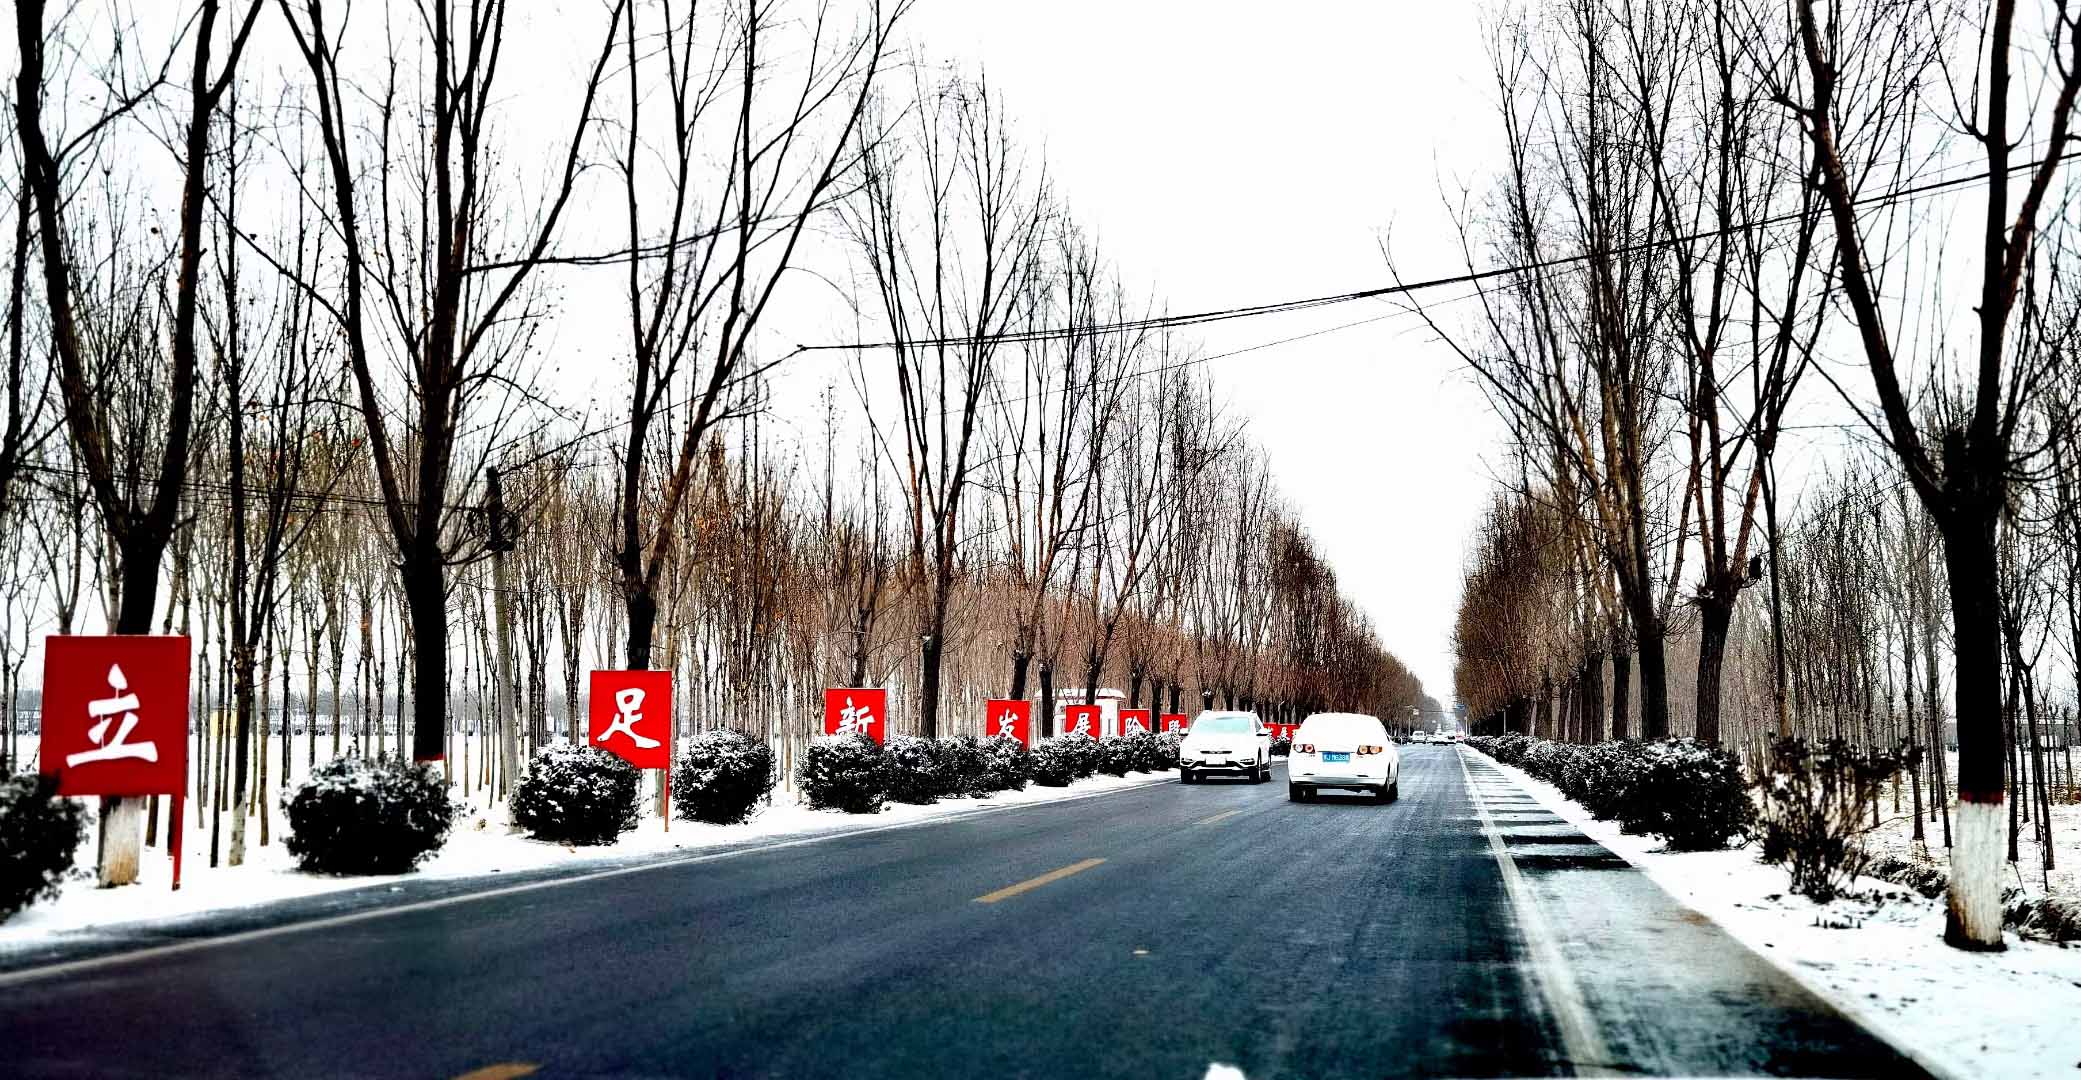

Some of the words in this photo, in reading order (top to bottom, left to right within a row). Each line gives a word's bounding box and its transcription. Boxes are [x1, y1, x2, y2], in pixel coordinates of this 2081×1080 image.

[67, 664, 157, 767] 立
[598, 688, 660, 748] 足
[835, 696, 876, 736] 新
[998, 708, 1022, 742] 发
[1072, 712, 1095, 739] 展
[1125, 716, 1145, 737] 阶
